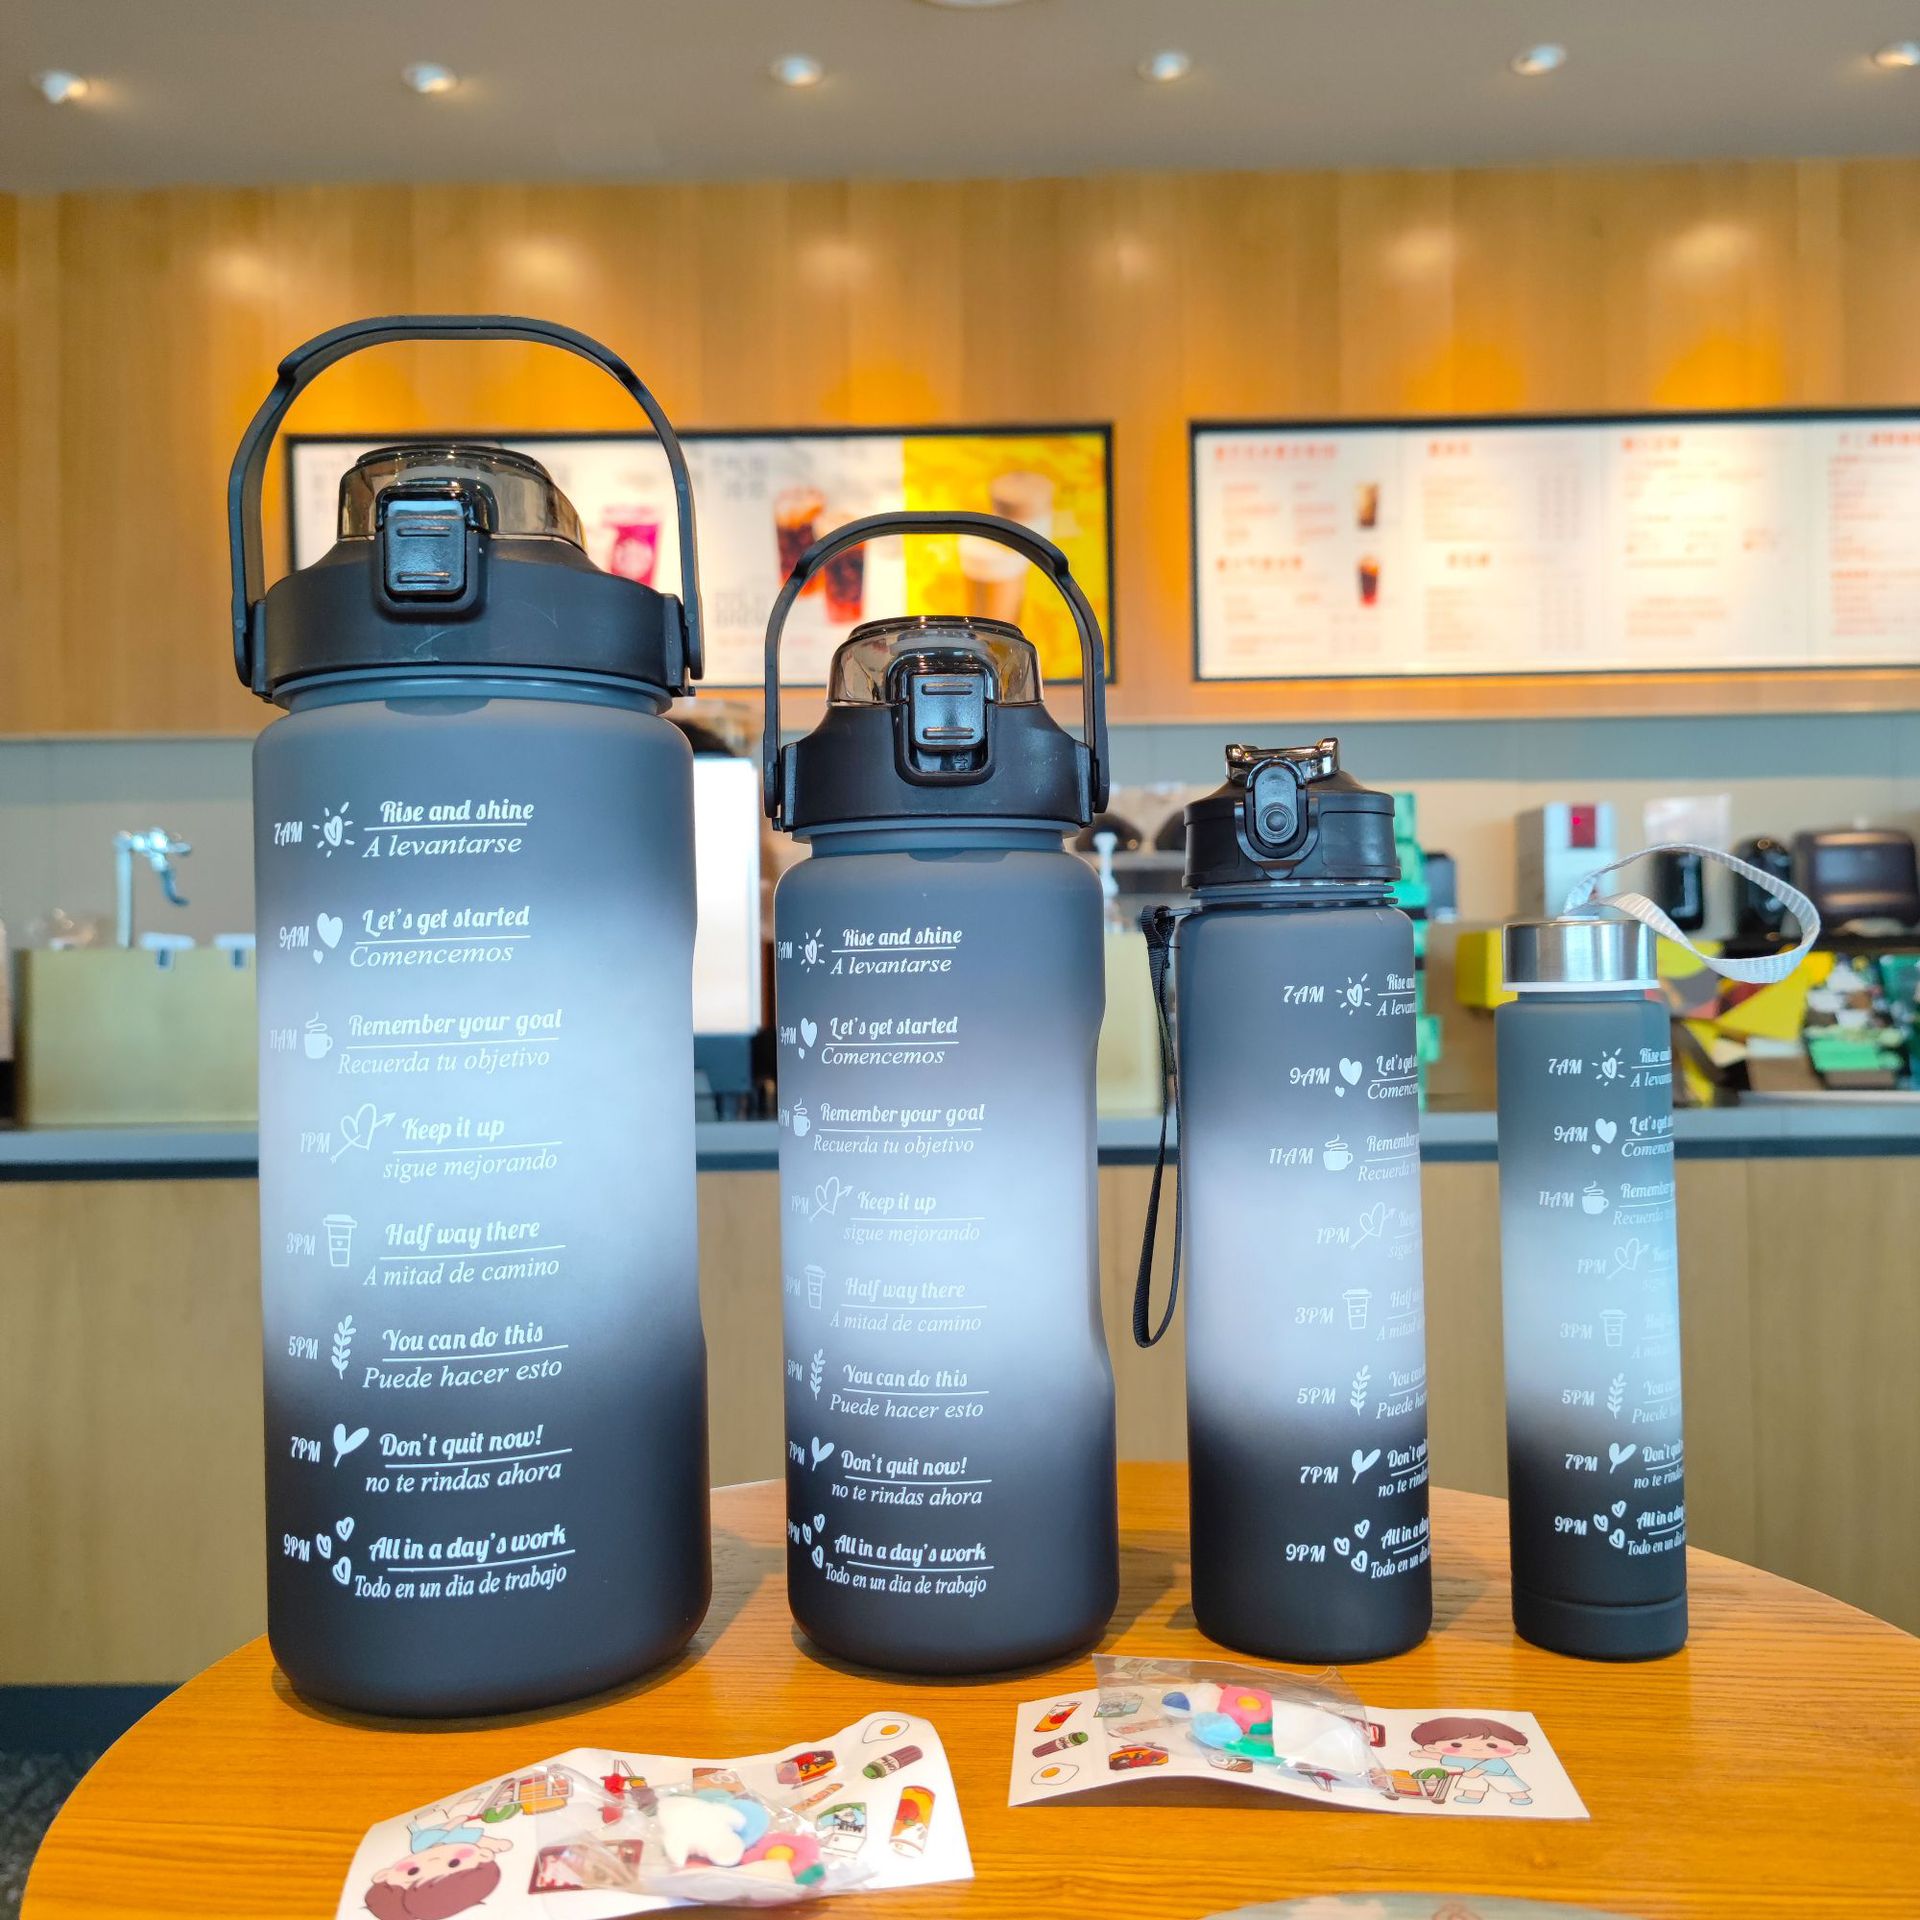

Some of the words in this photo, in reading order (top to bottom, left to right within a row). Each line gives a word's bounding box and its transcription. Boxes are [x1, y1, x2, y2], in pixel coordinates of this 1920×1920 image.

[380, 801, 424, 823] Rise
[428, 801, 471, 822] and
[476, 799, 534, 820] shine
[274, 821, 303, 846] 7AM
[362, 836, 381, 858] A
[389, 835, 522, 857] levantarse
[362, 909, 413, 936] Let's
[417, 910, 447, 935] get
[453, 906, 530, 928] started
[279, 926, 309, 948] 9AM
[843, 929, 874, 947] Rise
[878, 928, 911, 945] and
[915, 926, 963, 944] shine
[350, 945, 514, 968] Comencemos
[830, 957, 843, 975] A
[849, 957, 952, 974] levantarse
[1386, 973, 1405, 990] Rise
[1283, 986, 1324, 1004] 7AM
[1376, 1000, 1388, 1017] A
[349, 1014, 456, 1036] Remember
[459, 1015, 510, 1038] your
[516, 1009, 562, 1036] goal
[830, 1017, 866, 1040] Let's
[870, 1018, 893, 1040] get
[897, 1016, 958, 1035] started
[338, 1051, 429, 1075] Recuerda
[436, 1053, 457, 1071] tu
[464, 1046, 550, 1074] objetivo
[821, 1047, 945, 1064] Comencemos
[1376, 1053, 1402, 1076] Let's
[1548, 1059, 1582, 1075] 7AM
[1290, 1067, 1330, 1086] 9AM
[1630, 1074, 1641, 1087] A
[821, 1103, 898, 1122] Remember
[901, 1108, 940, 1127] your
[946, 1104, 985, 1126] goal
[301, 1132, 330, 1153] 1PM
[402, 1118, 452, 1145] Keep
[456, 1117, 471, 1138] it
[477, 1119, 505, 1141] up
[1554, 1126, 1588, 1143] 9AM
[814, 1135, 879, 1152] Recuerda
[884, 1138, 899, 1153] tu
[905, 1136, 974, 1158] objetivo
[1268, 1148, 1314, 1166] 11AM
[383, 1159, 437, 1183] sigue
[444, 1149, 558, 1181] mejorando
[858, 1191, 894, 1215] Keep
[898, 1193, 909, 1210] it
[914, 1197, 936, 1214] up
[1538, 1191, 1574, 1208] 11AM
[286, 1233, 316, 1256] 3PM
[385, 1224, 433, 1251] Half
[436, 1226, 481, 1248] way
[486, 1221, 540, 1241] there
[843, 1225, 884, 1245] sigue
[888, 1223, 980, 1246] mejorando
[1317, 1227, 1350, 1244] 1PM
[363, 1266, 377, 1286] A
[383, 1263, 443, 1286] mitad
[449, 1262, 474, 1283] de
[481, 1257, 560, 1281] camino
[1577, 1259, 1606, 1274] 1PM
[845, 1278, 881, 1302] Half
[883, 1284, 919, 1304] way
[922, 1282, 966, 1298] there
[830, 1312, 840, 1327] A
[844, 1313, 889, 1331] mitad
[892, 1314, 913, 1332] de
[918, 1316, 982, 1331] camino
[1295, 1307, 1334, 1324] 3PM
[382, 1329, 424, 1352] You
[428, 1330, 466, 1350] can
[470, 1327, 498, 1347] do
[504, 1322, 544, 1345] this
[1560, 1323, 1592, 1339] 3PM
[288, 1336, 318, 1360] 5PM
[363, 1368, 432, 1389] Puede
[439, 1366, 509, 1387] hacer
[516, 1360, 563, 1380] esto
[843, 1364, 873, 1385] You
[876, 1371, 905, 1385] can
[908, 1371, 931, 1387] do
[935, 1370, 968, 1387] this
[1388, 1370, 1410, 1387] You
[830, 1394, 879, 1416] Puede
[885, 1400, 939, 1418] hacer
[945, 1402, 983, 1418] esto
[1297, 1388, 1336, 1405] 5PM
[1376, 1396, 1413, 1420] Puede
[1562, 1389, 1595, 1406] 5PM
[290, 1436, 321, 1462] 7PM
[380, 1433, 437, 1457] Don't
[441, 1432, 484, 1460] quit
[489, 1424, 544, 1451] now!
[789, 1441, 805, 1465] 7PM
[841, 1450, 882, 1474] Don't
[886, 1457, 919, 1478] quit
[922, 1457, 967, 1475] now!
[1387, 1445, 1416, 1468] Don't
[1565, 1454, 1598, 1471] 7PM
[365, 1475, 389, 1493] no
[396, 1474, 415, 1492] te
[421, 1468, 490, 1492] rindas
[497, 1461, 562, 1486] ahora
[1300, 1466, 1339, 1484] 7PM
[1634, 1477, 1649, 1488] no
[1652, 1474, 1662, 1486] te
[832, 1483, 849, 1498] no
[853, 1485, 866, 1500] te
[871, 1487, 923, 1505] rindas
[929, 1488, 982, 1505] ahora
[1378, 1484, 1394, 1498] no
[1397, 1479, 1407, 1494] te
[1554, 1516, 1587, 1535] 9PM
[1637, 1511, 1656, 1529] All
[1657, 1509, 1667, 1525] in
[284, 1534, 310, 1562] 9PM
[369, 1537, 400, 1561] All
[404, 1538, 423, 1560] in
[429, 1541, 442, 1559] a
[447, 1532, 506, 1563] day's
[511, 1524, 566, 1550] work
[1380, 1527, 1400, 1550] All
[1402, 1525, 1412, 1543] in
[1627, 1539, 1651, 1555] Todo
[1653, 1541, 1663, 1552] en
[835, 1534, 856, 1554] All
[859, 1542, 873, 1557] in
[876, 1547, 887, 1559] a
[890, 1543, 937, 1567] day's
[940, 1543, 986, 1562] work
[1285, 1544, 1326, 1562] 9PM
[826, 1562, 850, 1584] Todo
[853, 1574, 866, 1589] en
[870, 1577, 886, 1590] un
[889, 1574, 911, 1592] dia
[915, 1577, 931, 1593] de
[936, 1575, 987, 1597] trabajo
[1370, 1558, 1396, 1579] Todo
[1397, 1559, 1408, 1573] en
[354, 1575, 391, 1598] Todo
[395, 1581, 415, 1598] en
[420, 1579, 441, 1598] un
[445, 1576, 474, 1597] dia
[479, 1571, 500, 1593] de
[504, 1564, 567, 1591] trabajo
